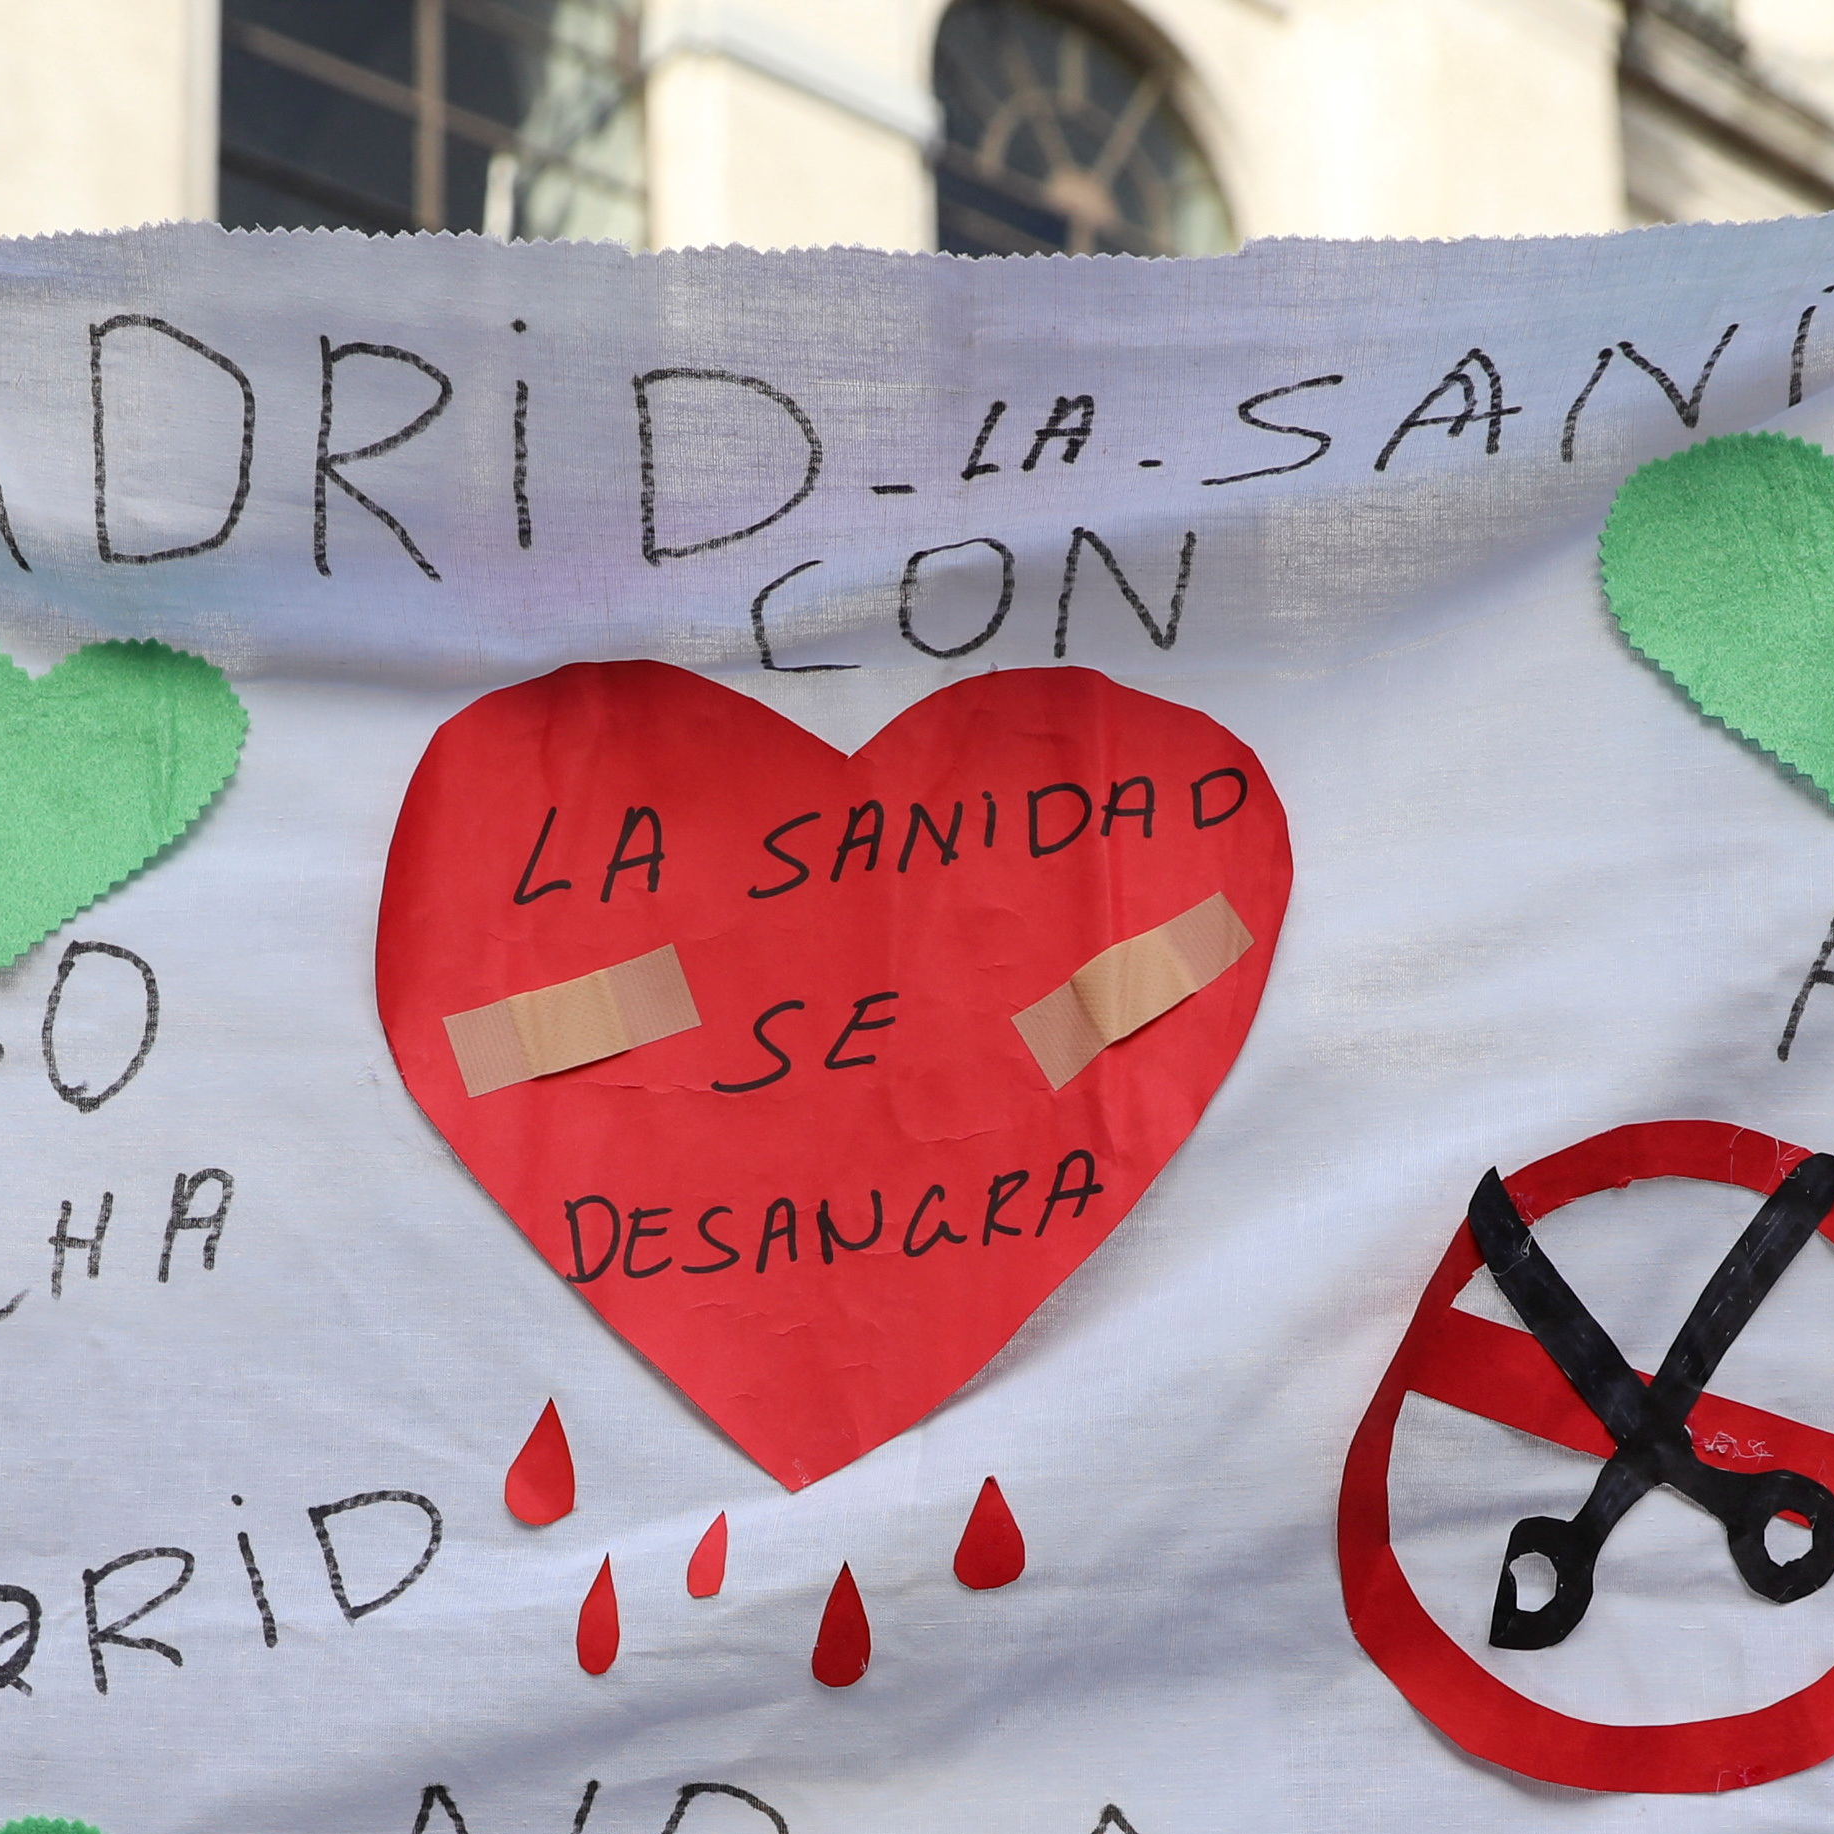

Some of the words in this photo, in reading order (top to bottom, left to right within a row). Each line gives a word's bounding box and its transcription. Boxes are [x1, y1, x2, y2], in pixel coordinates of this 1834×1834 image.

[750, 527, 1198, 673] CON
[512, 805, 667, 907] LA
[710, 990, 900, 1095] SE
[563, 1148, 1105, 1285] DESANGRA
